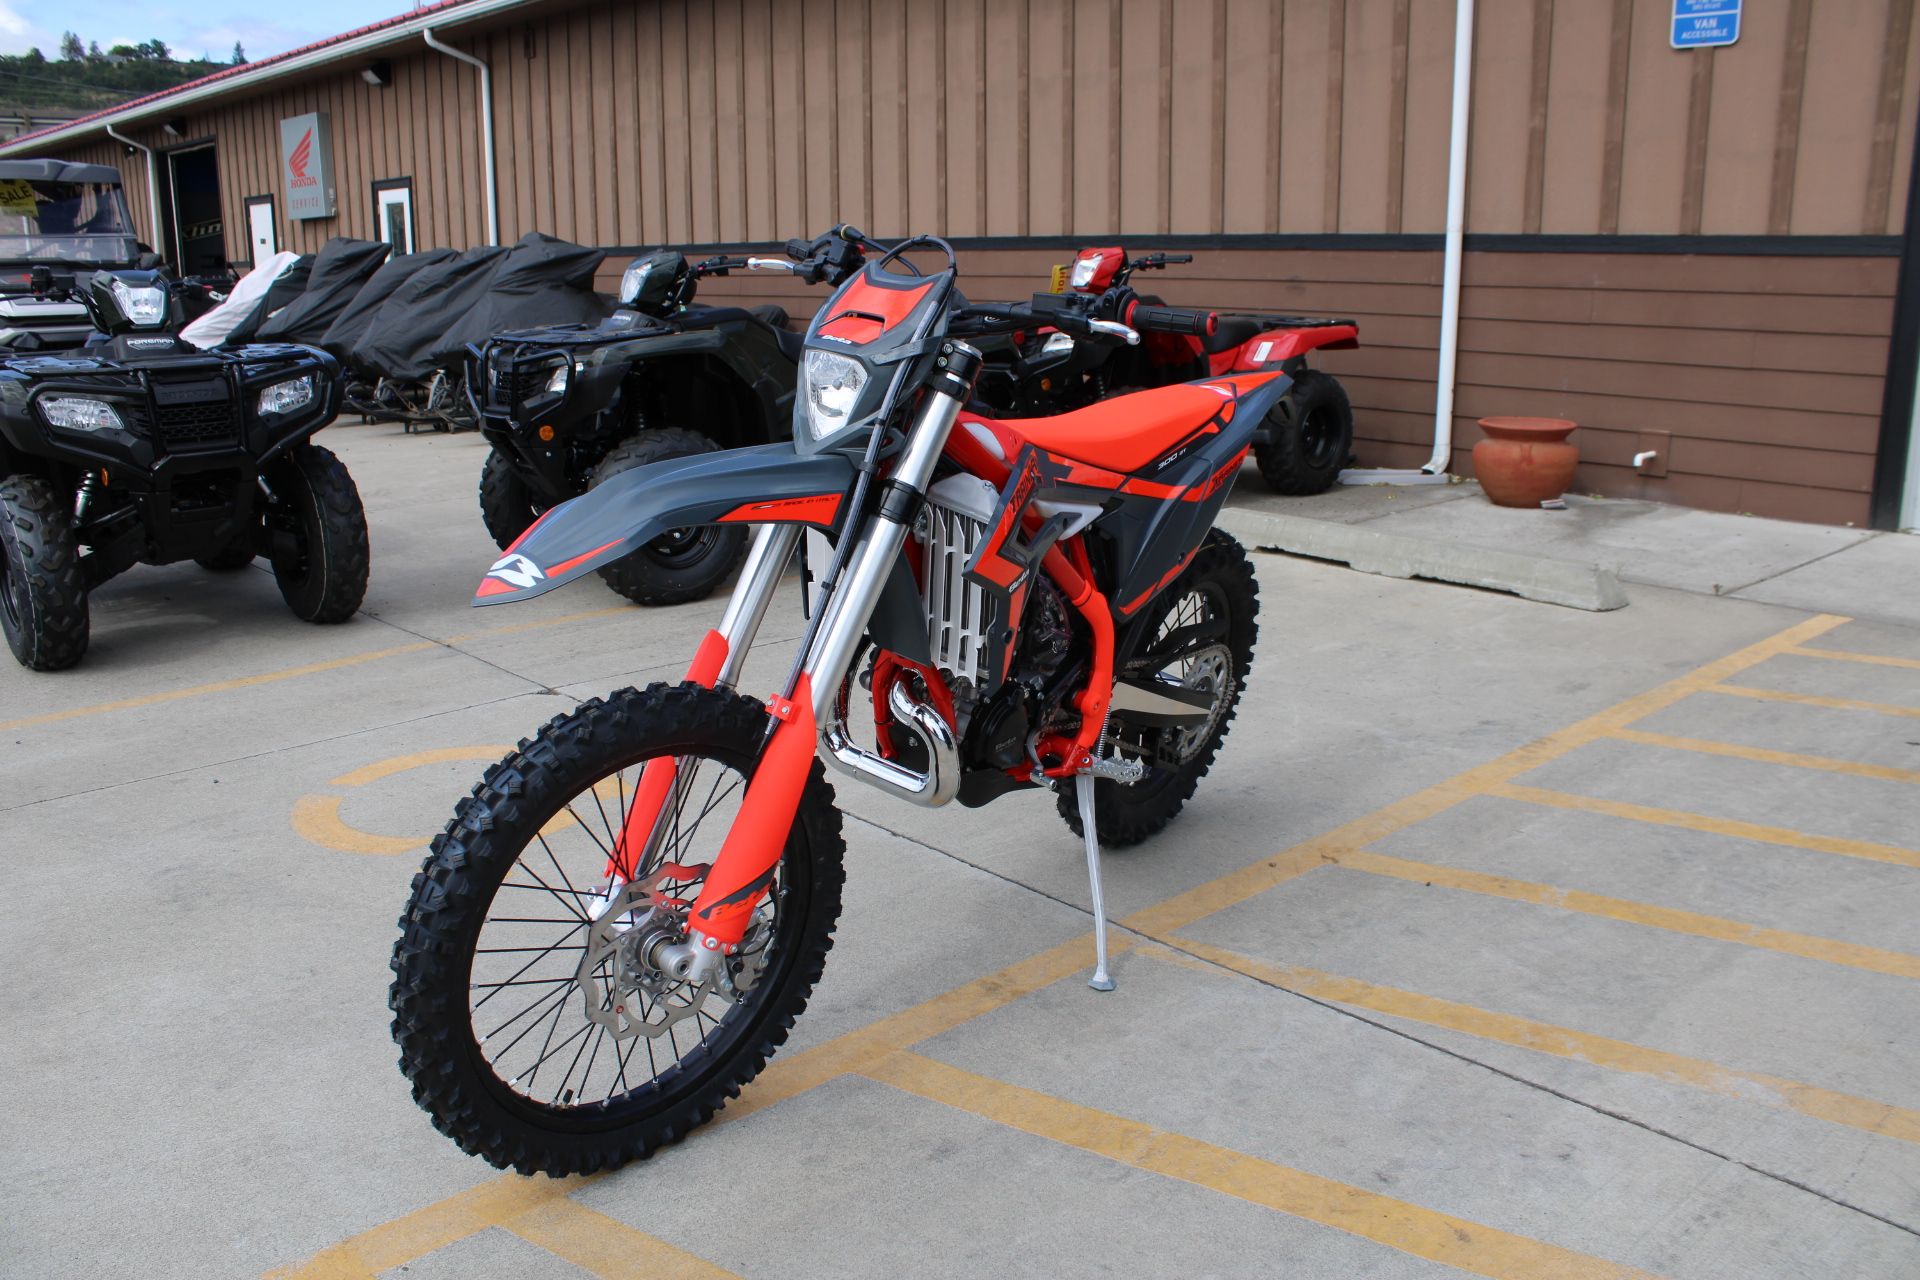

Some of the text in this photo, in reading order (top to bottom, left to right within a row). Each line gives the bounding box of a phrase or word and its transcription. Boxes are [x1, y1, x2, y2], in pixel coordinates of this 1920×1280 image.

[1694, 18, 1717, 29] VAN
[1681, 28, 1728, 39] ACCESSIBLE
[291, 176, 317, 188] HONDA
[293, 197, 319, 210] SERVICE
[126, 337, 175, 346] FOREMAN
[821, 335, 852, 345] Beta
[1157, 453, 1178, 470] 300
